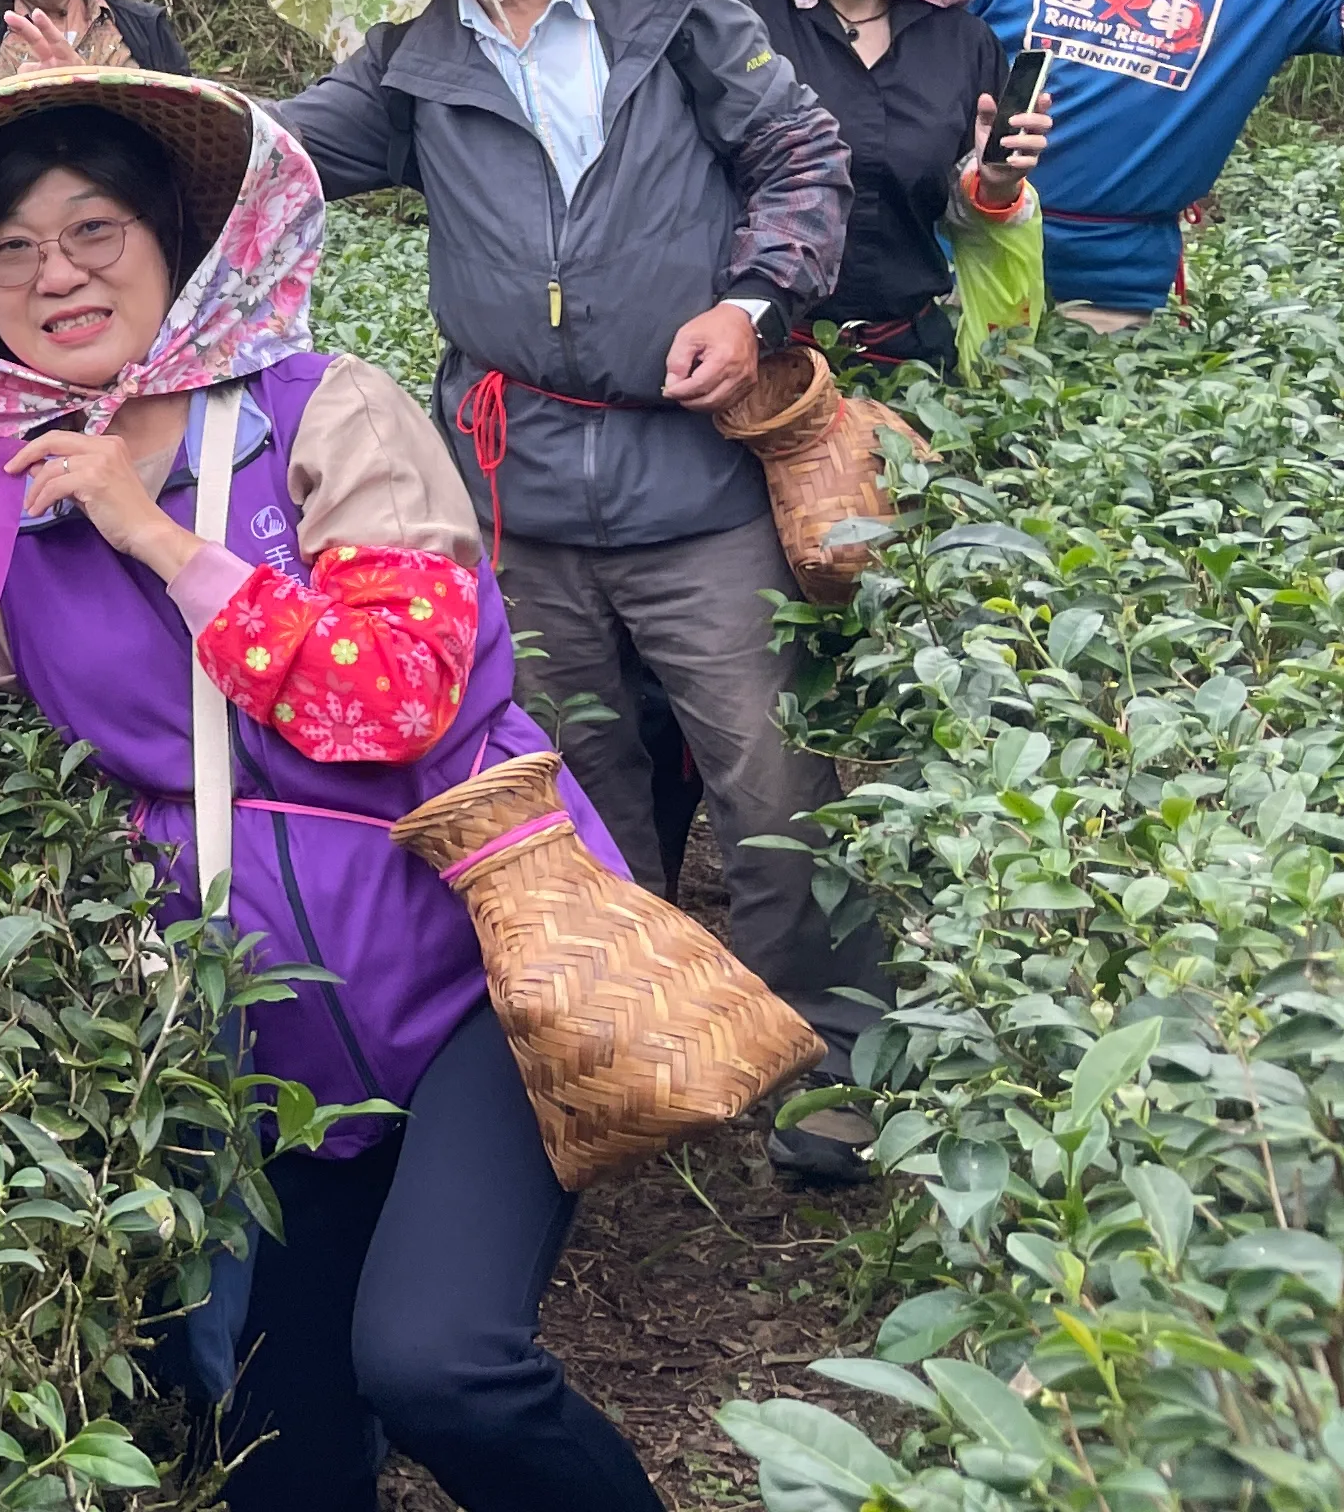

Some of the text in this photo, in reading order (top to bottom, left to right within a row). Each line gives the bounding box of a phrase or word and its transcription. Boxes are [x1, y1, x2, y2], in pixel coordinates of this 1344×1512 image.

[1044, 7, 1167, 49] RAILWAY RELAY
[1065, 44, 1153, 75] RUNNING
